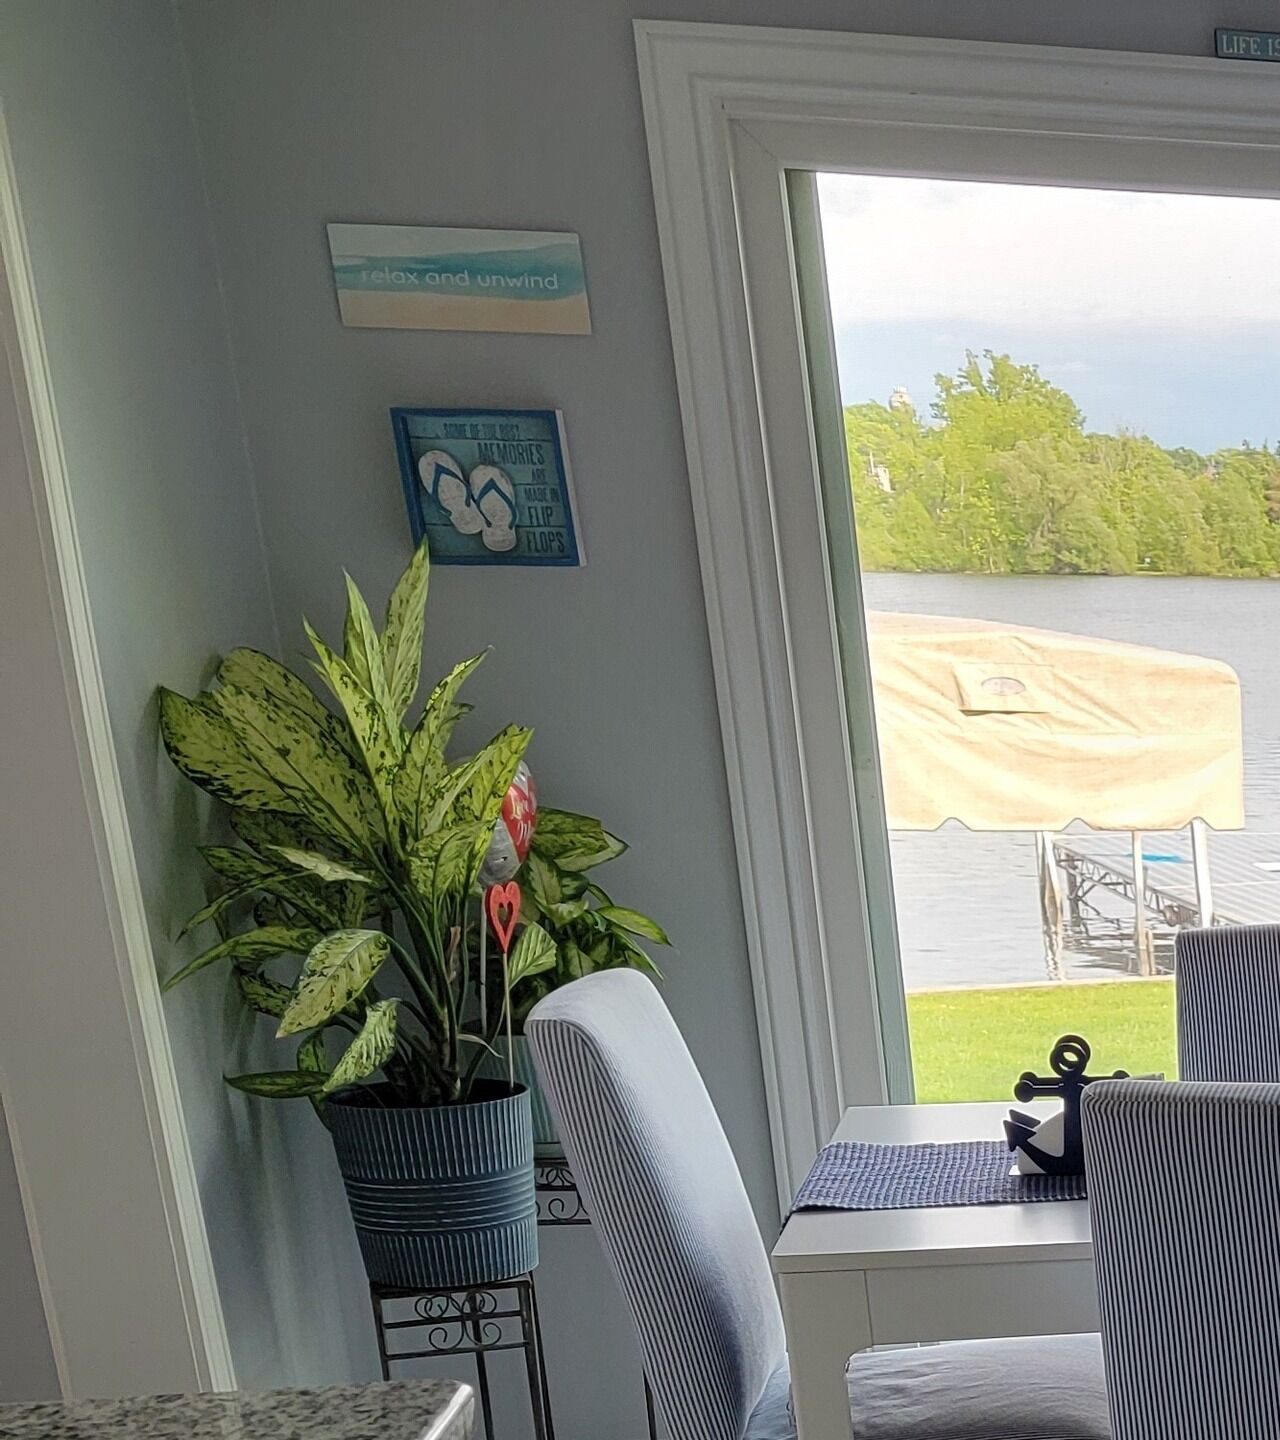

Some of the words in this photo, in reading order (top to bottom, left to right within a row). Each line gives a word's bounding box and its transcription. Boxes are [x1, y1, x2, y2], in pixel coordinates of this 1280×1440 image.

[1221, 34, 1260, 56] LIFE
[360, 266, 420, 286] relax
[425, 269, 470, 288] and
[477, 272, 559, 290] unwind
[478, 442, 545, 465] MEMORIES
[524, 487, 548, 502] MADE
[528, 506, 553, 526] FLIP
[526, 532, 565, 553] FLOPS
